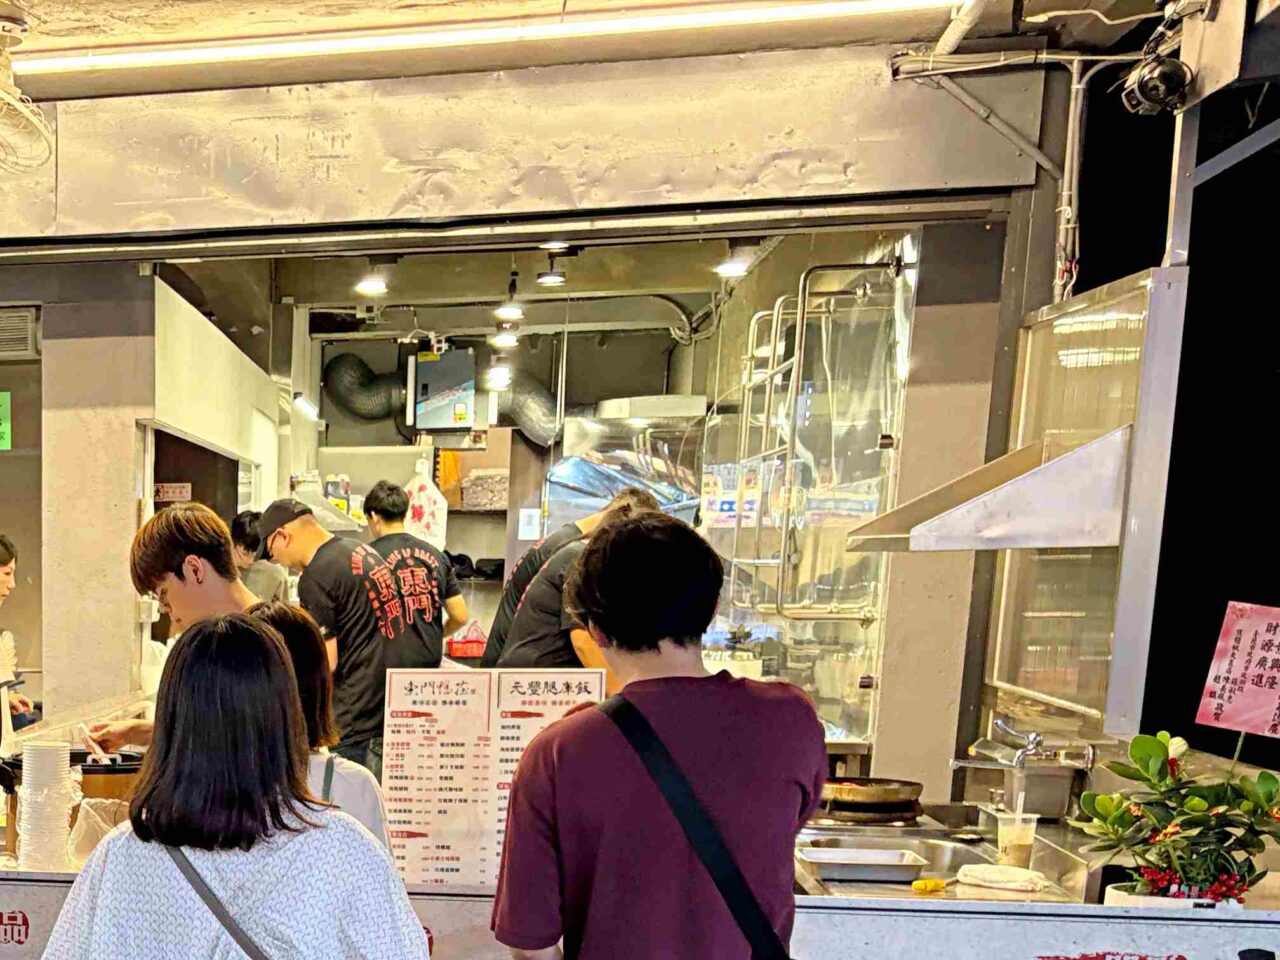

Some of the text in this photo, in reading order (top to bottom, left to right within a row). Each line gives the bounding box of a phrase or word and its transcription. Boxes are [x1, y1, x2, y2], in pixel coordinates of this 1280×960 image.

[397, 567, 433, 624] 東門
[510, 681, 592, 696] 元豐腿庫飯
